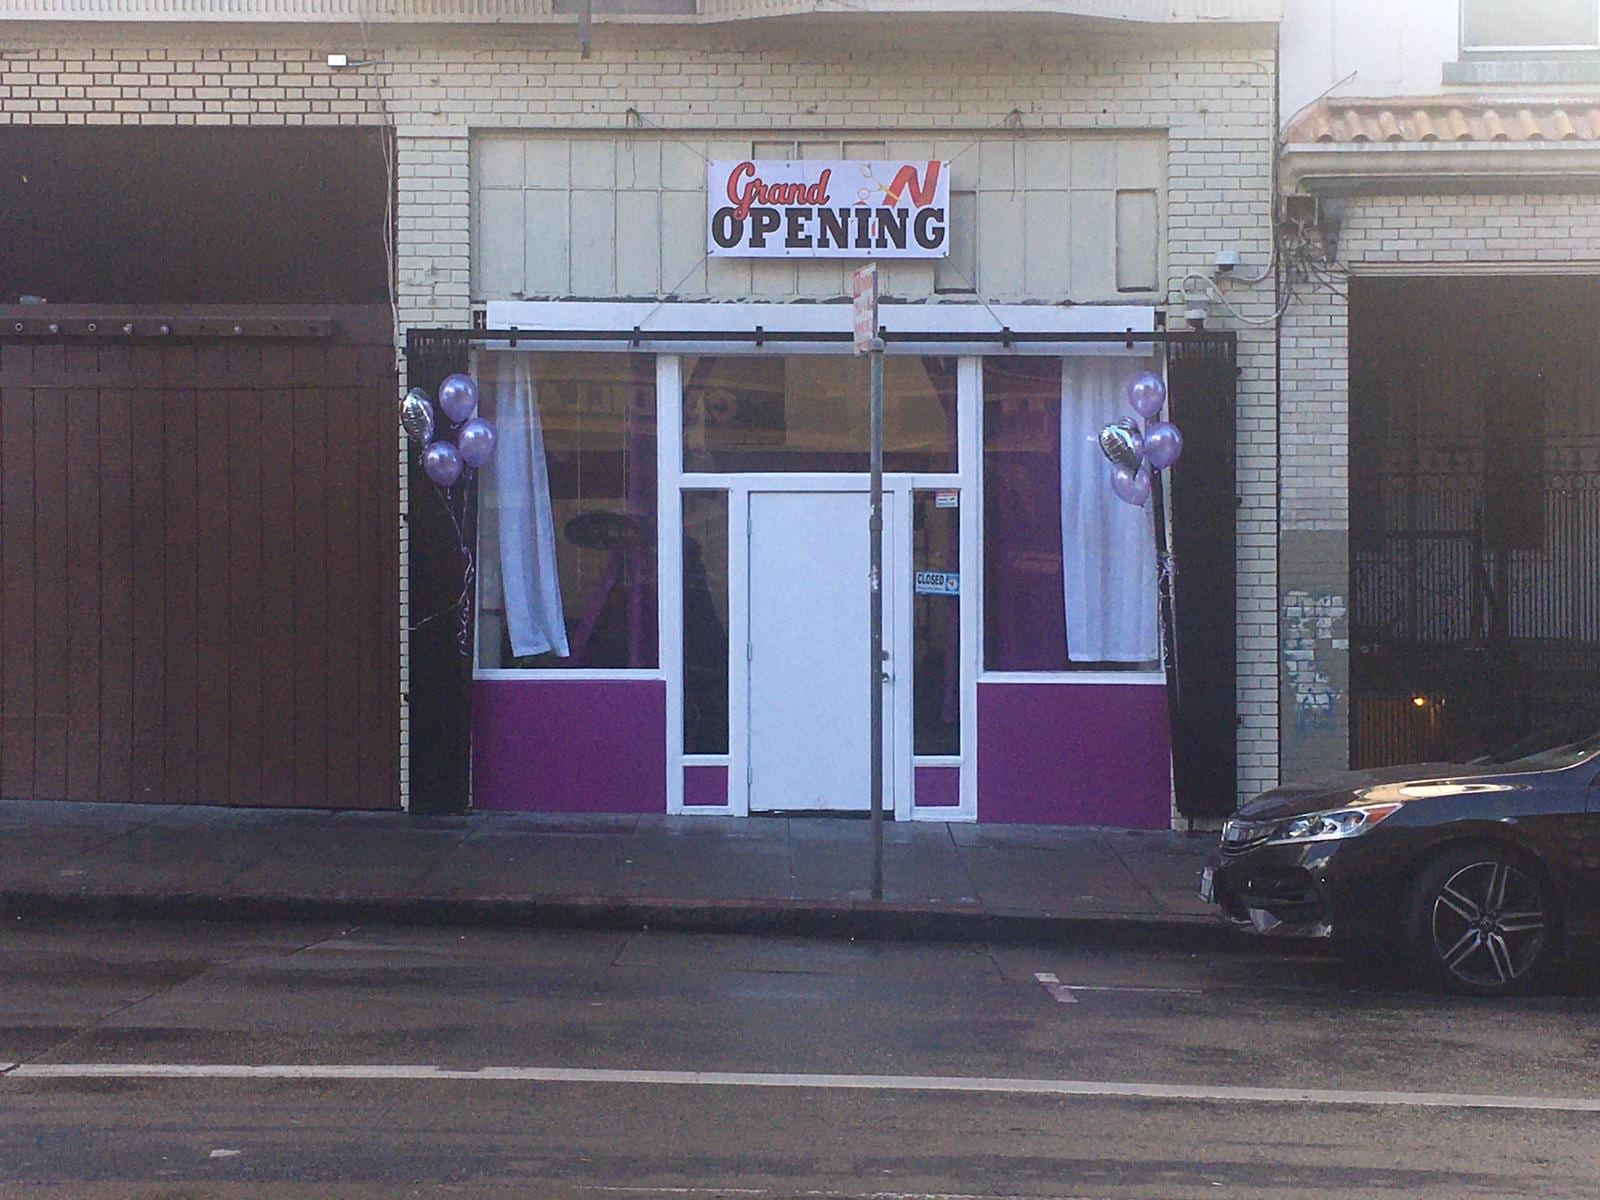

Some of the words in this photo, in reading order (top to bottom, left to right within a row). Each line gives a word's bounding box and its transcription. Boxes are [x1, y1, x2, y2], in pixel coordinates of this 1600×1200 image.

[727, 161, 831, 220] Grand
[712, 207, 946, 249] OPENING
[917, 574, 944, 586] CLOSED
